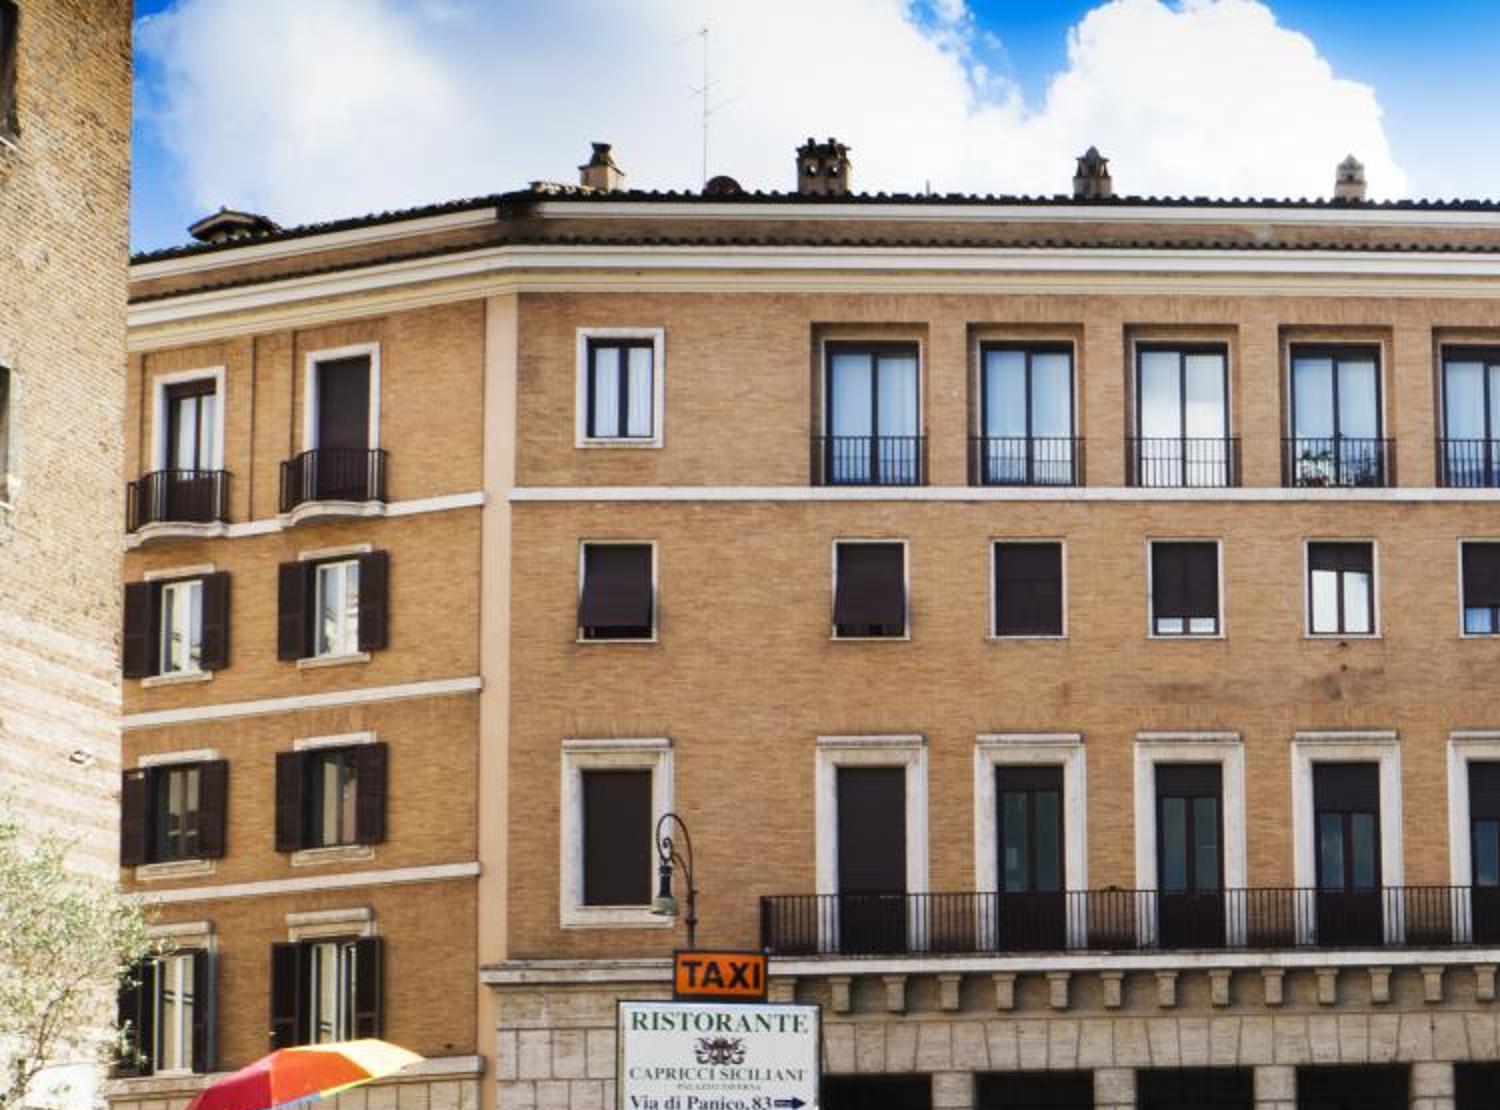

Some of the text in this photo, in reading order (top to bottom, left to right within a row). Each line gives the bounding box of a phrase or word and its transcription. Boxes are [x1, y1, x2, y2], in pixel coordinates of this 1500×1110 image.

[682, 959, 761, 990] TAXI
[631, 1011, 809, 1034] RISTORANTE
[629, 1067, 809, 1083] CAPRICCI SICILIANI
[631, 1095, 659, 1110] Via
[664, 1095, 681, 1110] di
